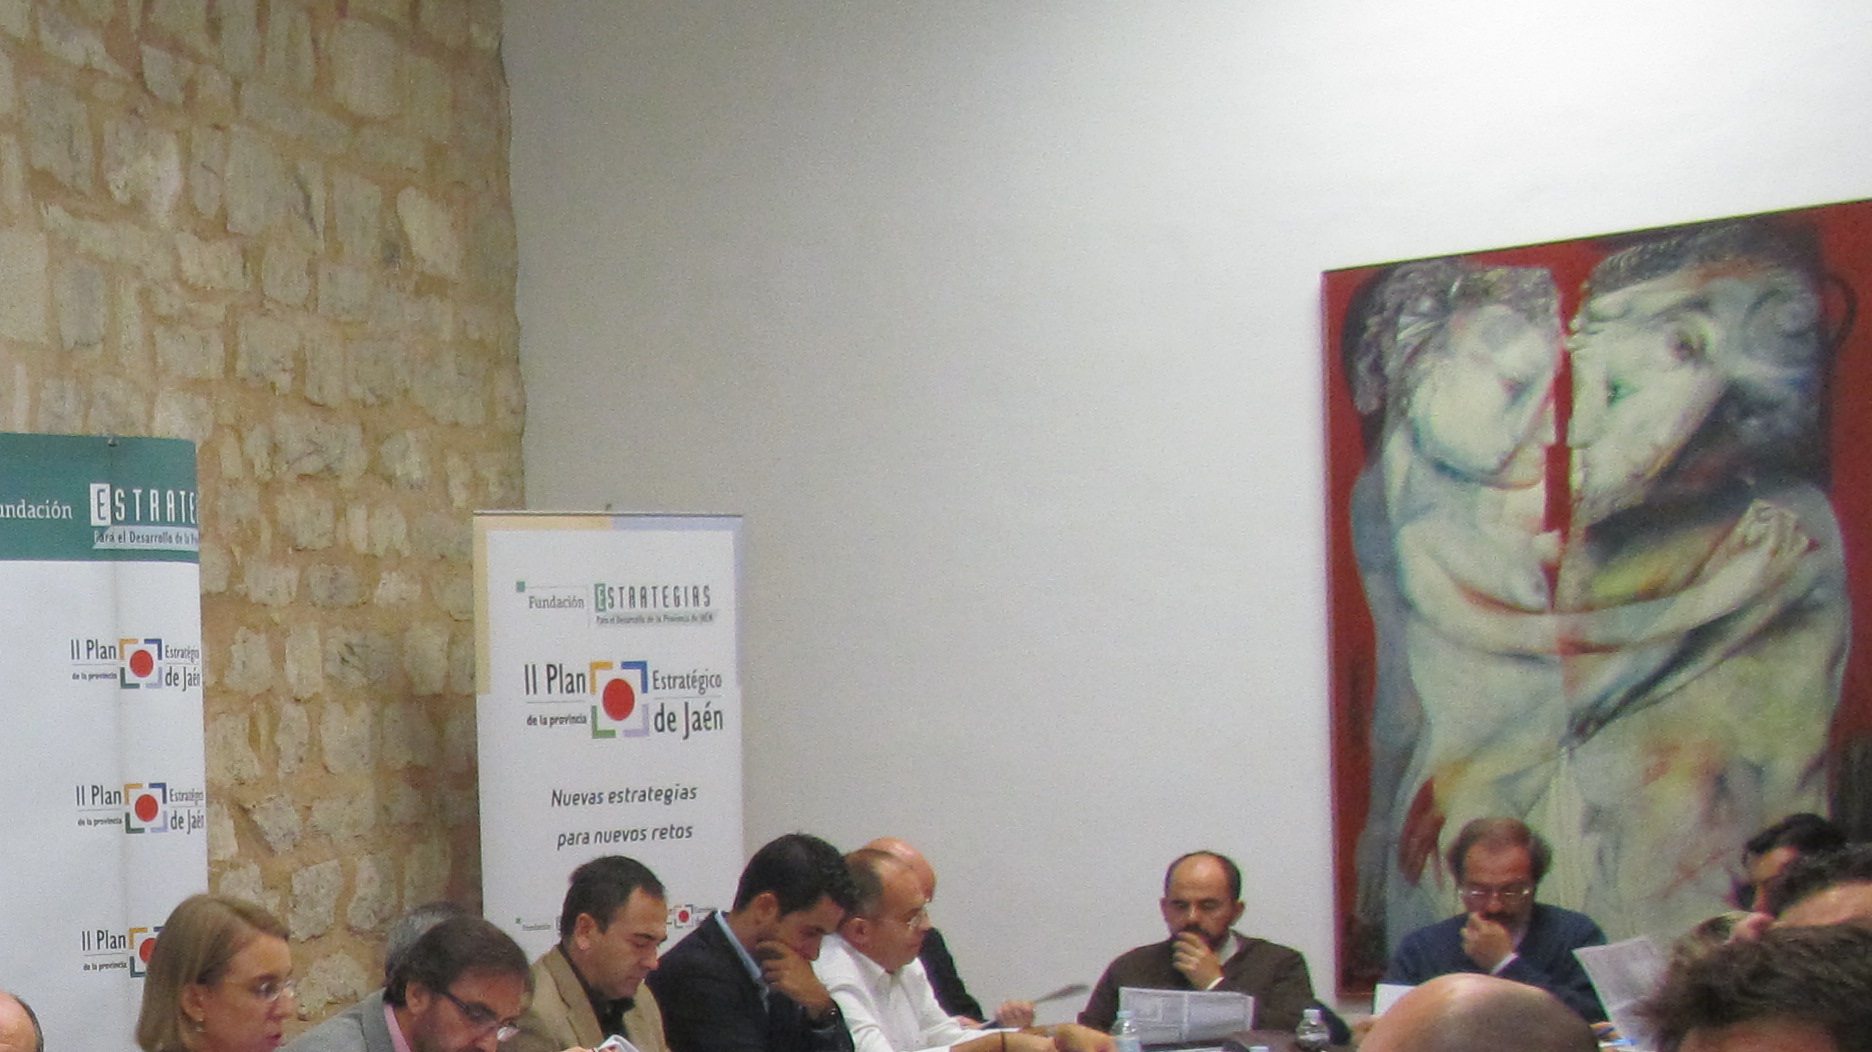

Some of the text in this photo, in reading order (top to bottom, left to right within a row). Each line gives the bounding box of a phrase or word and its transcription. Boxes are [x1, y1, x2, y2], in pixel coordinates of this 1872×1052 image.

[93, 486, 198, 524] ESTRATE
[117, 530, 127, 543] el
[129, 530, 173, 545] Desarrollo
[528, 584, 711, 610] Fundación ESTRATEGIAS
[70, 638, 117, 660] II Plan
[165, 666, 179, 687] de
[524, 663, 587, 697] II Plan
[652, 668, 723, 692] Estratégico
[526, 712, 588, 728] de la provincia
[654, 701, 724, 740] de Jaén
[76, 785, 122, 806] II Plan
[551, 783, 698, 808] Nuevas estrategias
[170, 810, 184, 830] de
[557, 823, 694, 851] para nuevos retos
[81, 929, 126, 951] II Plan
